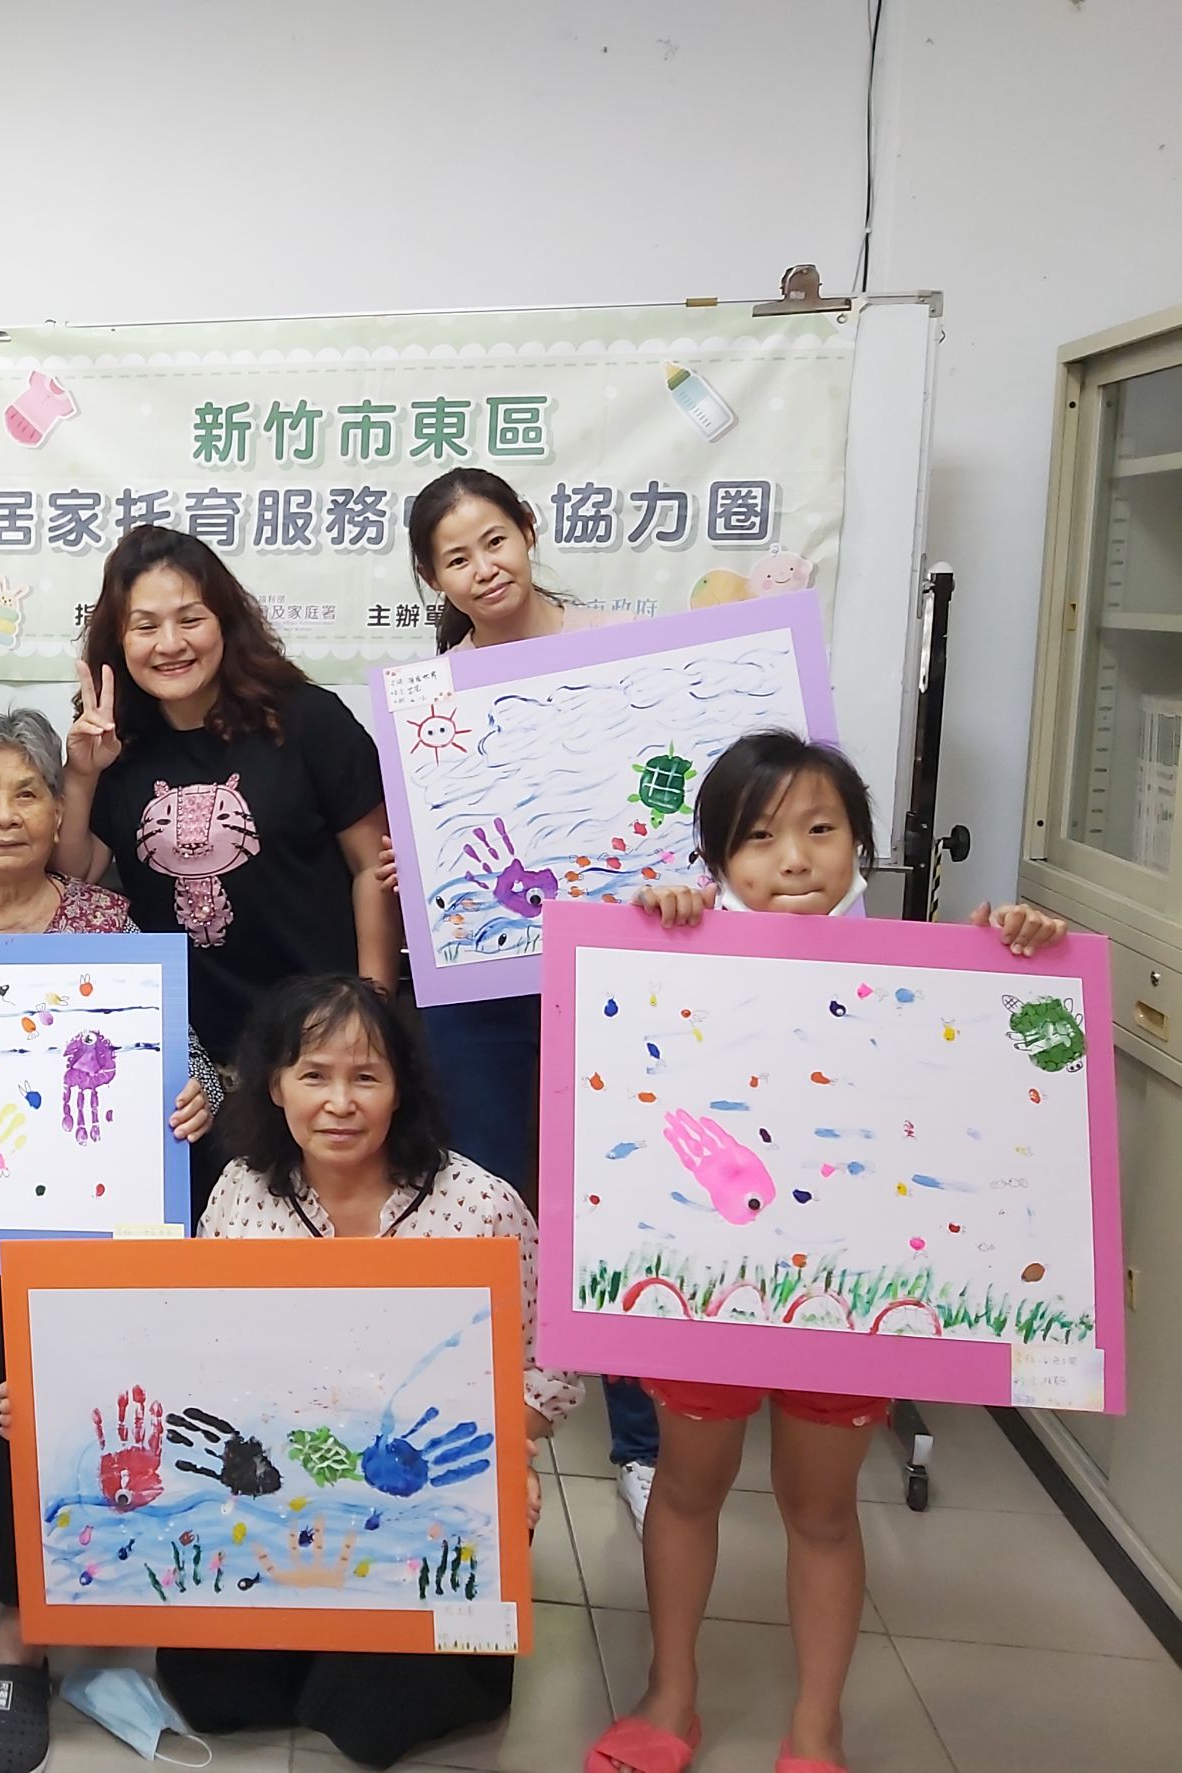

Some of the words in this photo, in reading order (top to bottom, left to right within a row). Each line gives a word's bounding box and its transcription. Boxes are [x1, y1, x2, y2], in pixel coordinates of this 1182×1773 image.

[192, 396, 548, 463] 新竹市東區
[367, 604, 445, 628] 主辦單
[586, 597, 659, 618] 市政府
